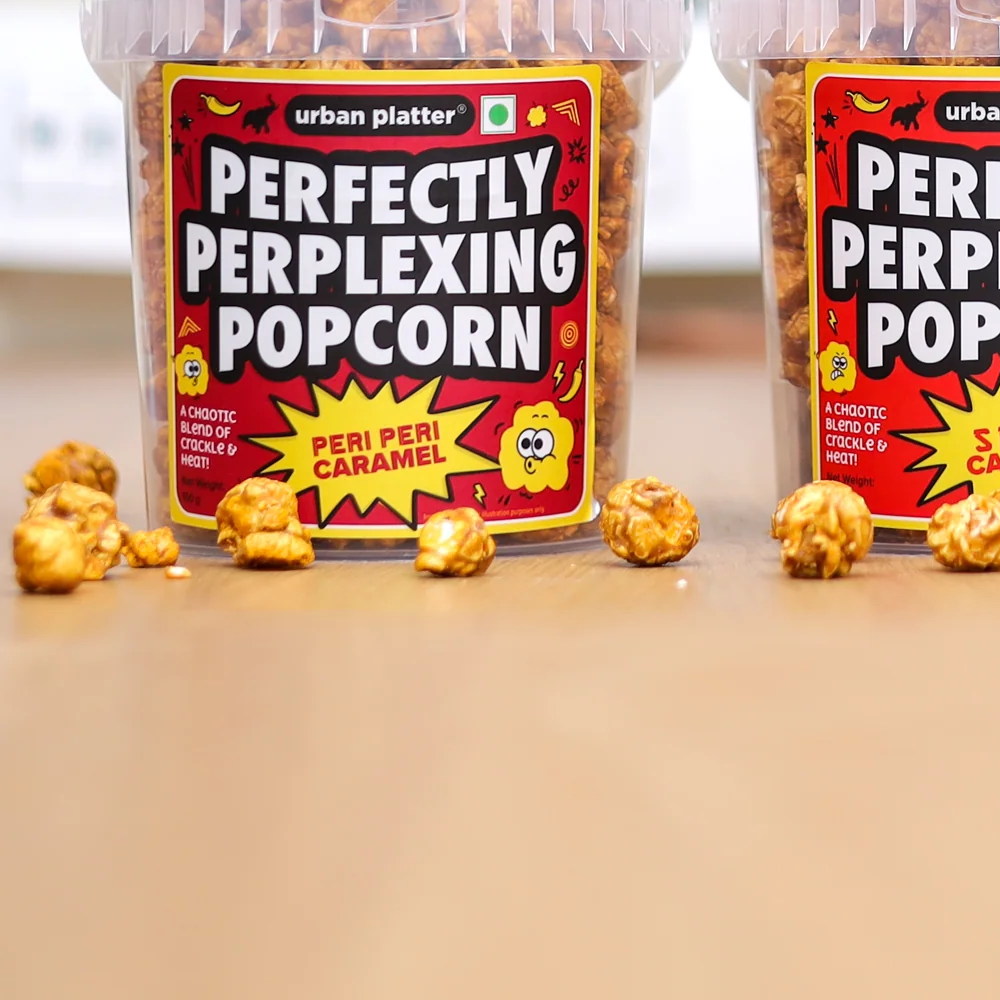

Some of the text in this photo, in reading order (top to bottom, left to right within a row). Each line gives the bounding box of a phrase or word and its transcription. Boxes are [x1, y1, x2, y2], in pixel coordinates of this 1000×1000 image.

[295, 105, 365, 125] urban
[212, 146, 553, 224] PERFECTLY
[187, 222, 576, 295] PERPLEXING
[219, 305, 540, 372] POPCORN
[180, 405, 187, 417] A
[825, 401, 832, 414] A
[215, 426, 231, 439] OF
[864, 422, 881, 435] OF
[312, 420, 440, 457] PERI PERI
[877, 440, 888, 452] &
[227, 443, 238, 456] &
[313, 444, 447, 480] CARAMEL
